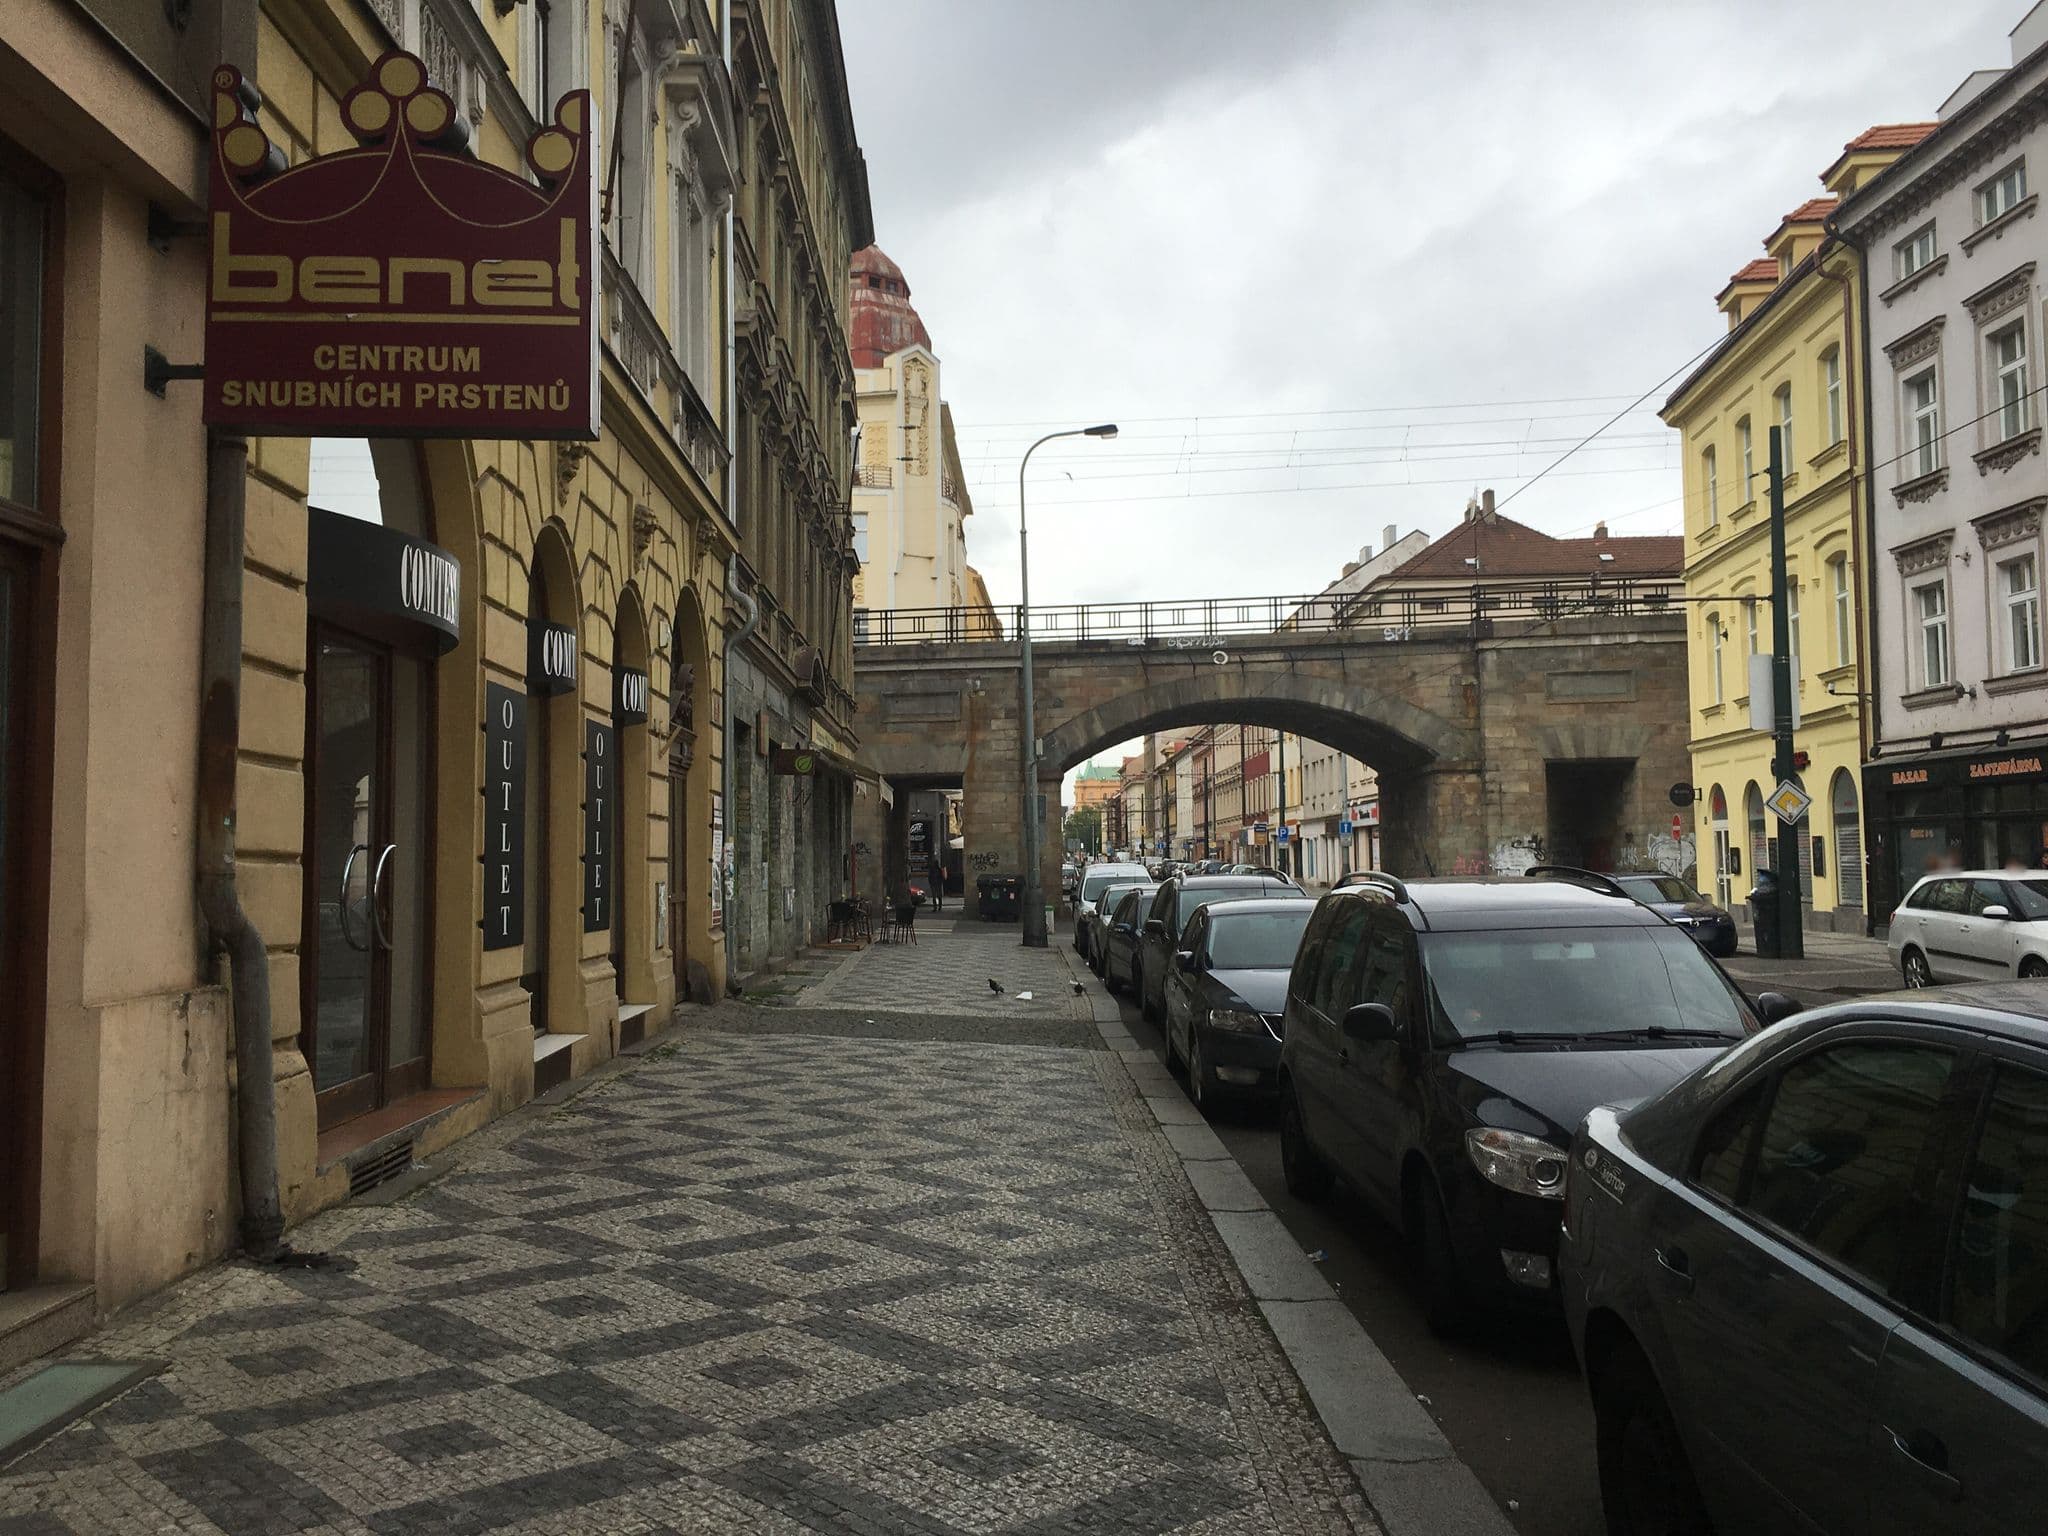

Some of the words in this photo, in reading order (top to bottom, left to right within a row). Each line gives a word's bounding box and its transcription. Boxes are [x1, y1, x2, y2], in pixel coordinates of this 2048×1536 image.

[212, 211, 580, 309] benet
[313, 345, 481, 372] CENTRUM
[222, 375, 401, 408] SNUBNÍCH
[415, 379, 570, 411] PRSTENŮ
[1892, 769, 1928, 785] BAZAR
[499, 699, 514, 937] OUTLET
[594, 732, 605, 922] OUTLET
